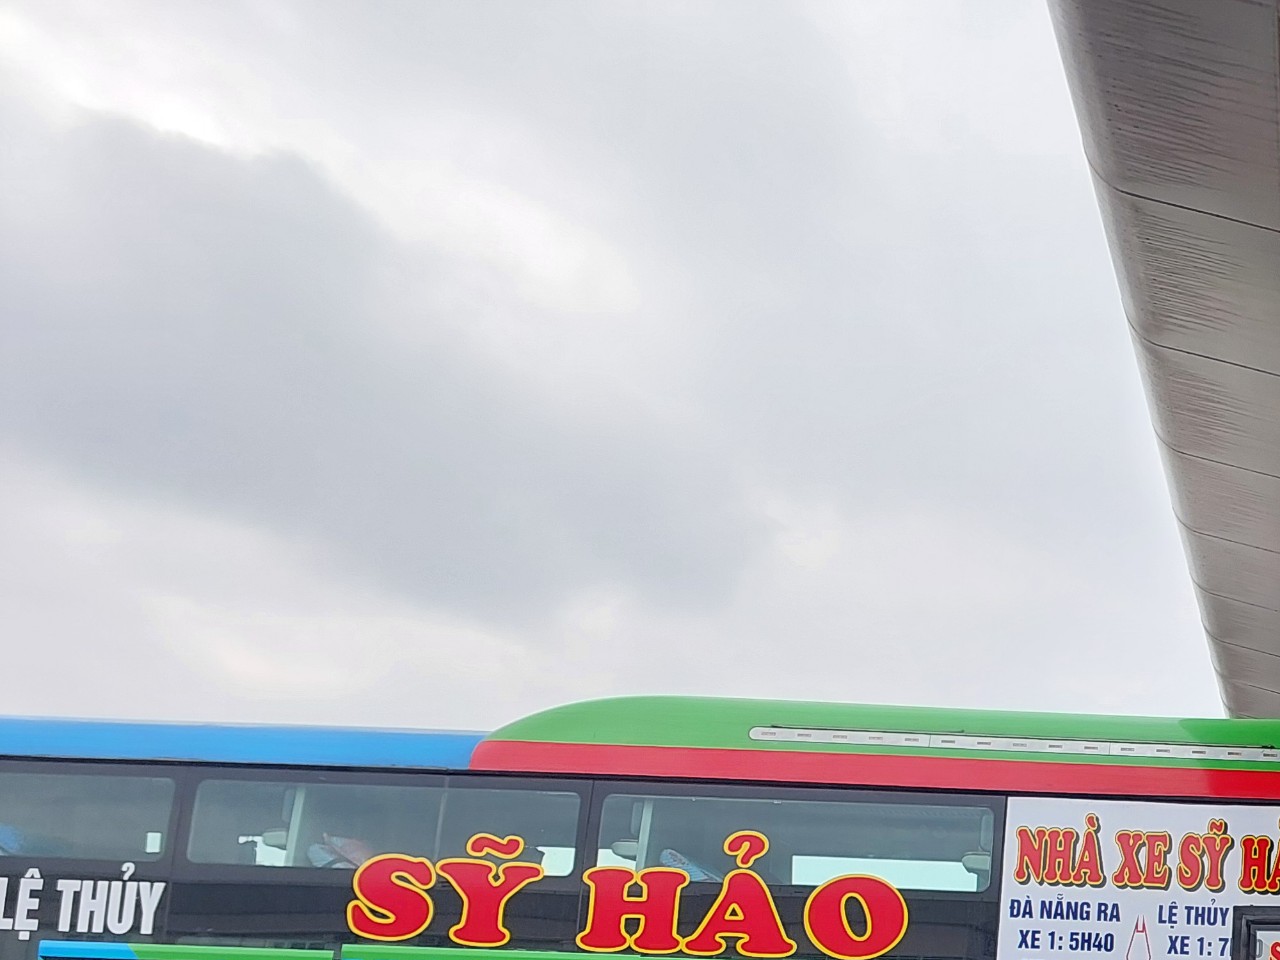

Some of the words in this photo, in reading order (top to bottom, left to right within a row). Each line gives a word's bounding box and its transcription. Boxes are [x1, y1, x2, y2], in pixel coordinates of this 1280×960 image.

[1014, 812, 1105, 887] NHÀ
[1112, 830, 1171, 890] XE
[1176, 818, 1233, 891] SỸ
[0, 867, 44, 941] LỆ
[57, 862, 166, 935] THỦY
[346, 832, 544, 948] SỸ
[575, 829, 909, 960] HẢO
[1009, 899, 1033, 919] ĐÀ
[1097, 903, 1120, 922] RA
[1158, 902, 1178, 929] LỆ
[1185, 899, 1229, 926] THỦY
[1018, 930, 1040, 949] XE
[1048, 931, 1063, 950] 1:
[1069, 932, 1114, 952] 5H40
[1167, 935, 1190, 955] XE
[1197, 937, 1212, 957] 1:
